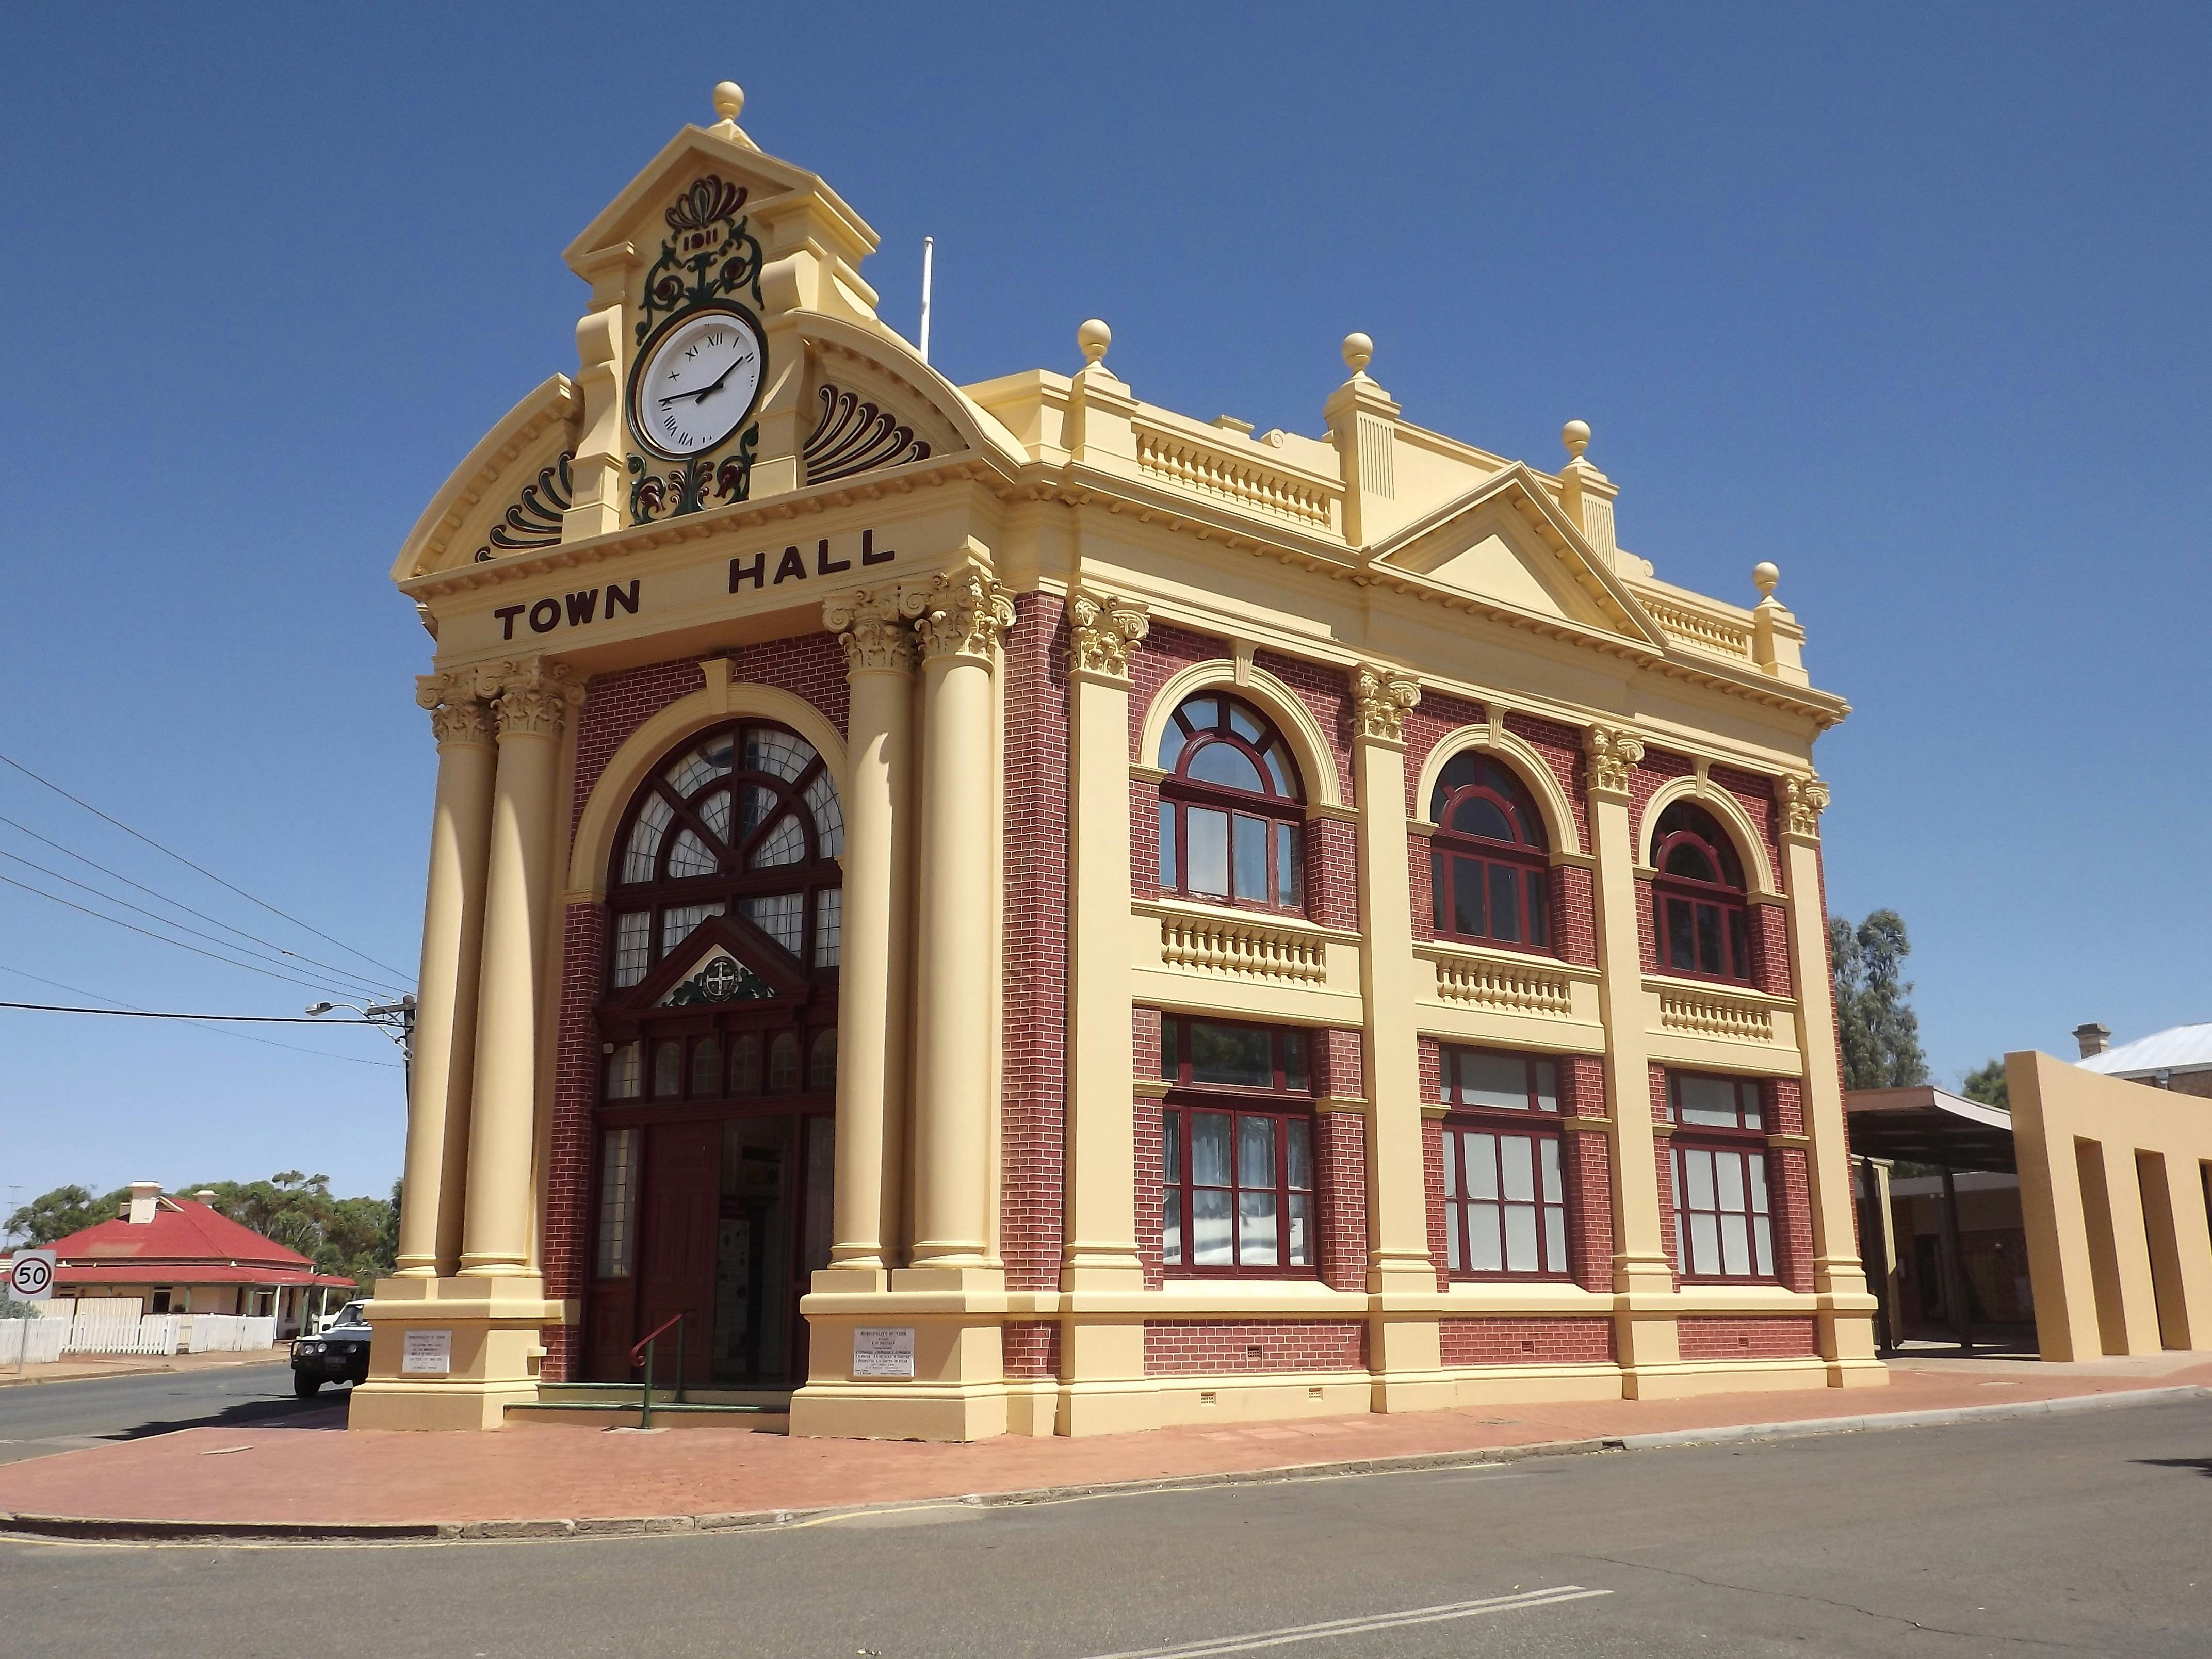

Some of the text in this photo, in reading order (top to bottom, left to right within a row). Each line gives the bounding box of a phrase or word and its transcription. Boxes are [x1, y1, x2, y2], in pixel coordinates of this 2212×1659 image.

[683, 227, 718, 251] 1911
[707, 333, 723, 348] XII
[685, 345, 699, 361] XI
[668, 370, 680, 381] X
[663, 415, 678, 437] VIII
[494, 529, 895, 640] TOWN HALL
[19, 1267, 46, 1285] 50
